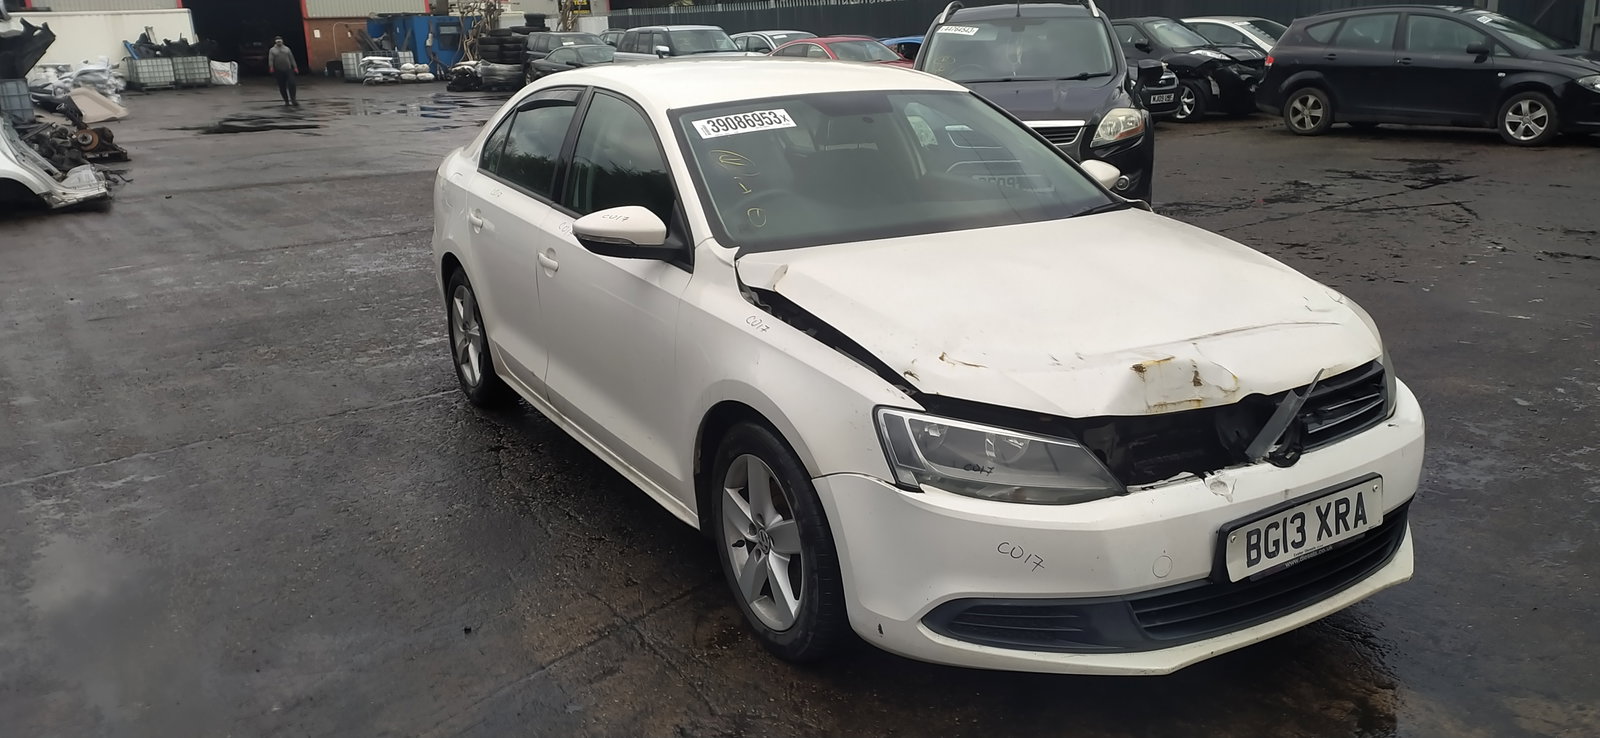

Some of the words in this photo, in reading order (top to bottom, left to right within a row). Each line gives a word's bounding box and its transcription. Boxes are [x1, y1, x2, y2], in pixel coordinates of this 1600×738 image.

[707, 111, 782, 133] 39086953
[1246, 511, 1307, 568] BG13
[1315, 491, 1368, 542] XRA
